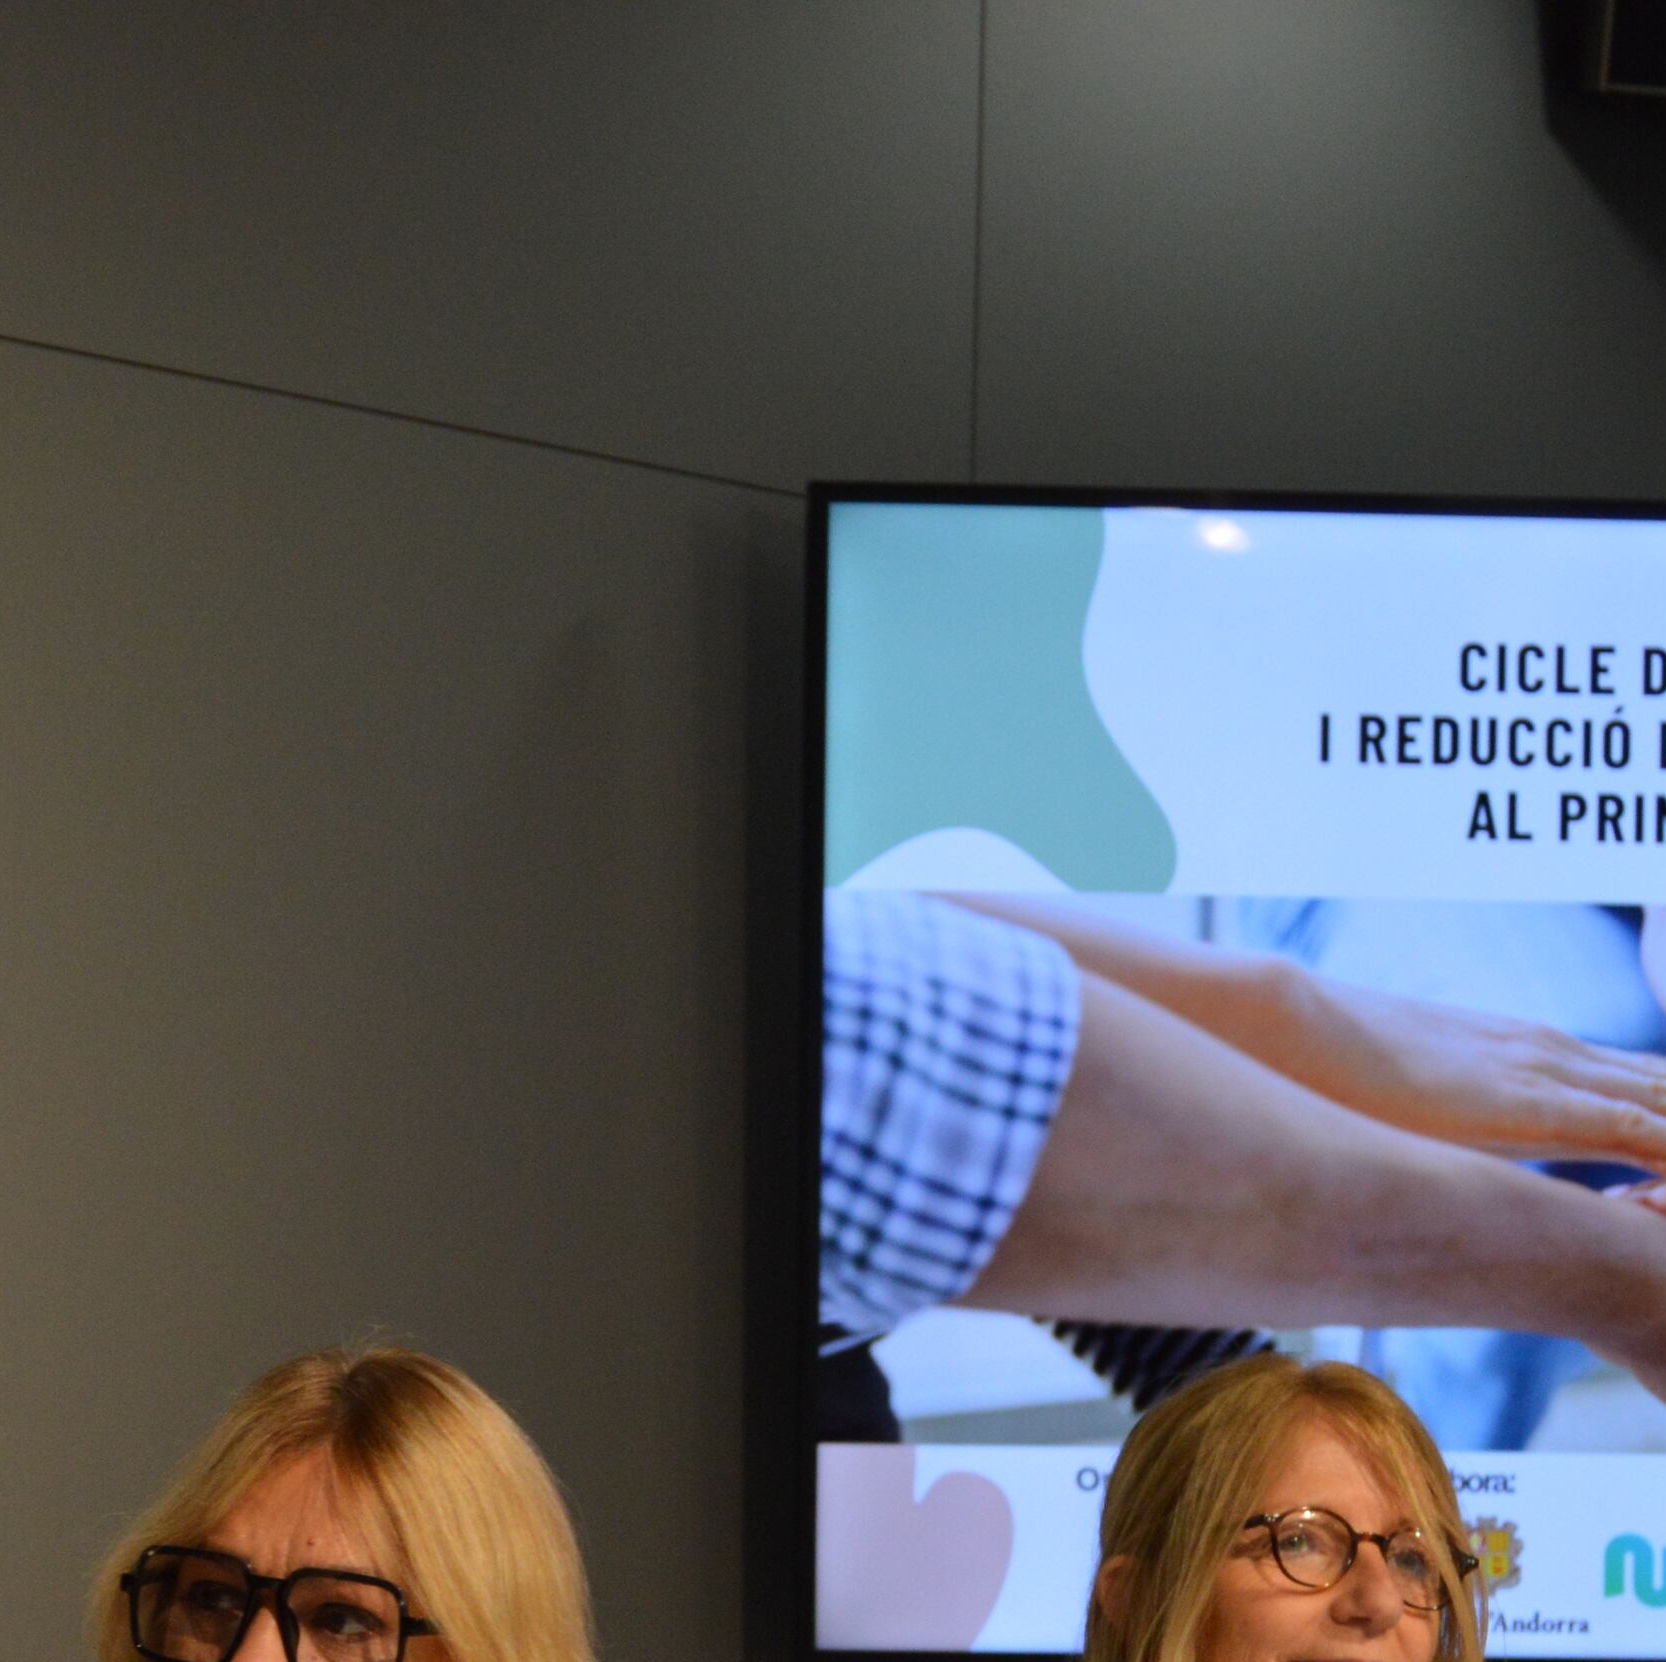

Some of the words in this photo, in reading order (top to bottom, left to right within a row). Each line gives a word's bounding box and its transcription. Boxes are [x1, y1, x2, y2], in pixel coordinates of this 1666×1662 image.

[1459, 642, 1616, 696] CICLE
[1319, 713, 1331, 763] I
[1358, 707, 1632, 770] REDUCCIÓ
[1467, 791, 1533, 841] AL
[1489, 1611, 1589, 1633] 'Andorra
